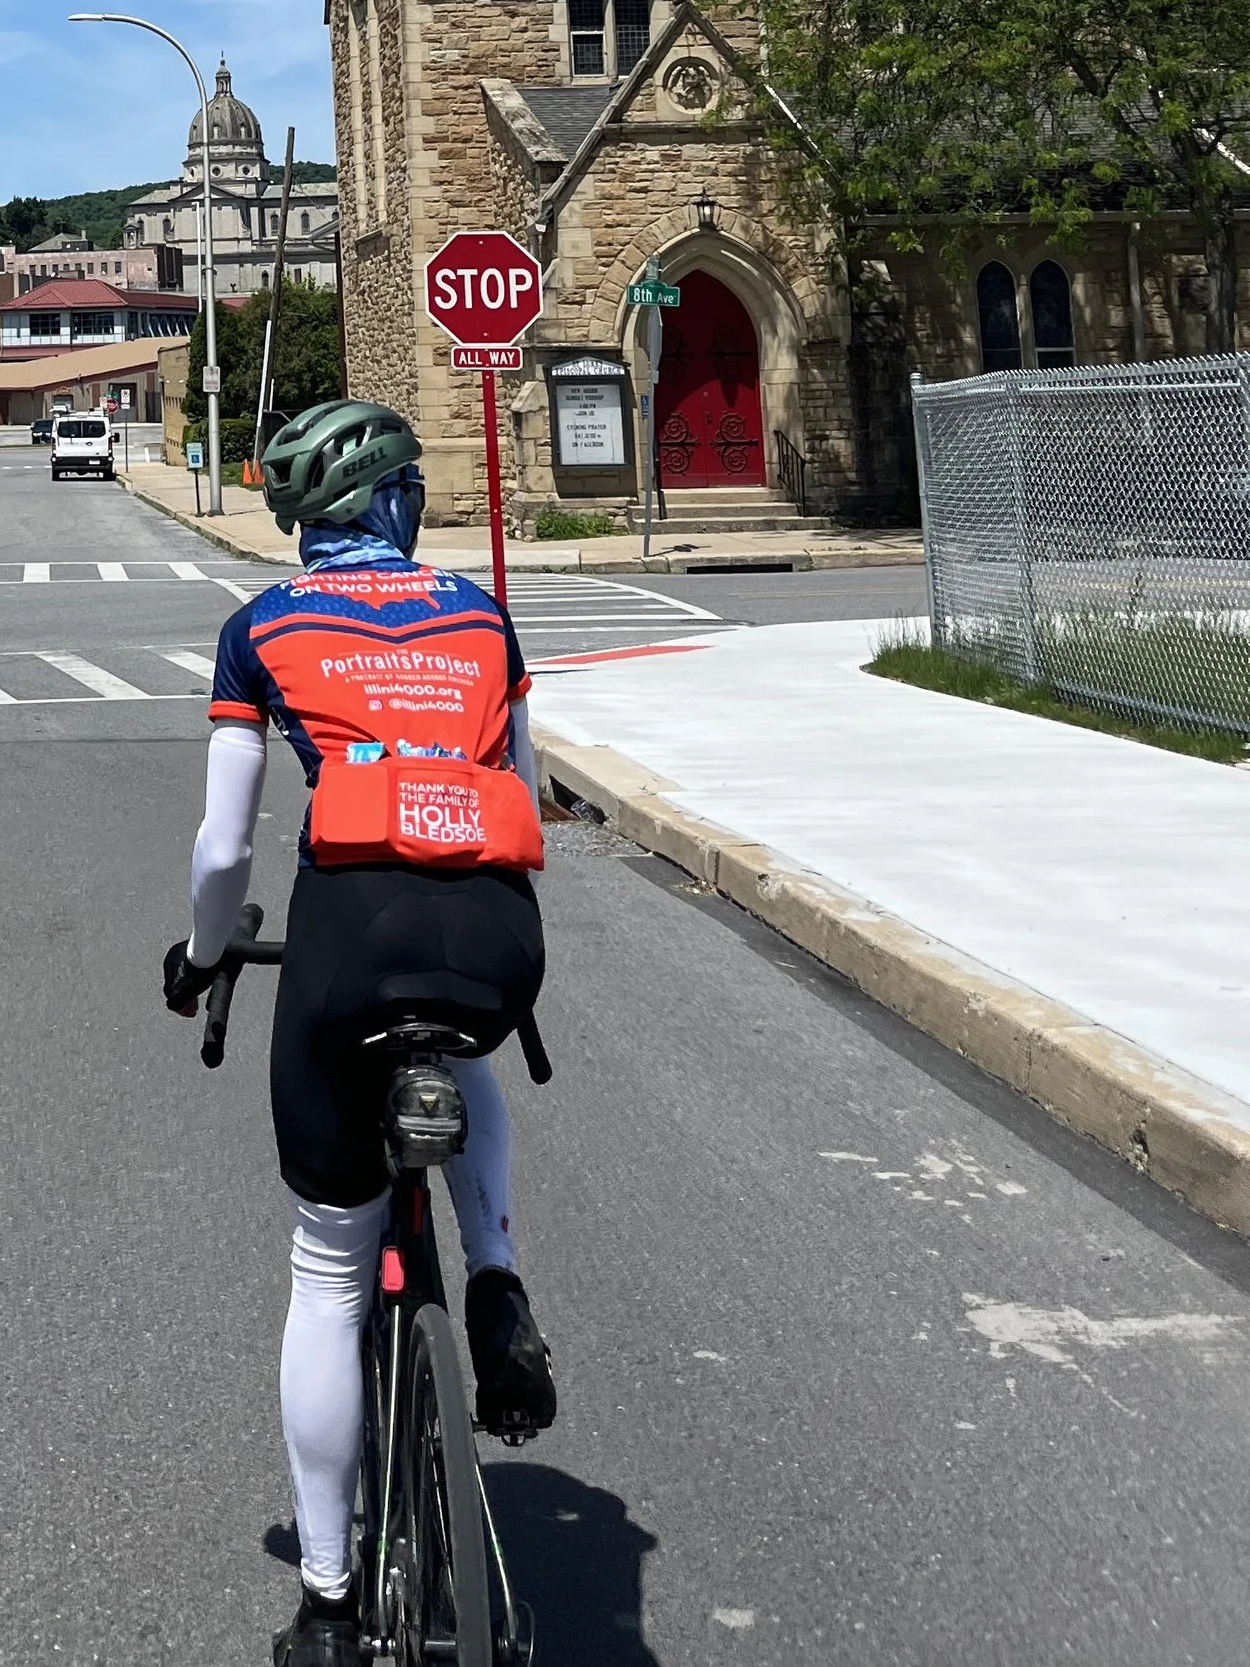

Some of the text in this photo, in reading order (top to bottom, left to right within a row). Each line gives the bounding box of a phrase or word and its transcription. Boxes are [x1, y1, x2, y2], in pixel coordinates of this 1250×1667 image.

[434, 268, 533, 310] STOP
[633, 287, 674, 304] 8th Ave
[459, 352, 515, 365] ALL WAY
[342, 446, 388, 476] BELL
[280, 566, 456, 590] FIGHTING CANCER
[290, 579, 458, 597] ON TWO WHEELS
[399, 782, 445, 793] THANK
[447, 784, 468, 796] YOU
[399, 792, 479, 809] THE FAMILY OF
[399, 802, 481, 829] HOLLY
[400, 821, 487, 843] BLEDSOE
